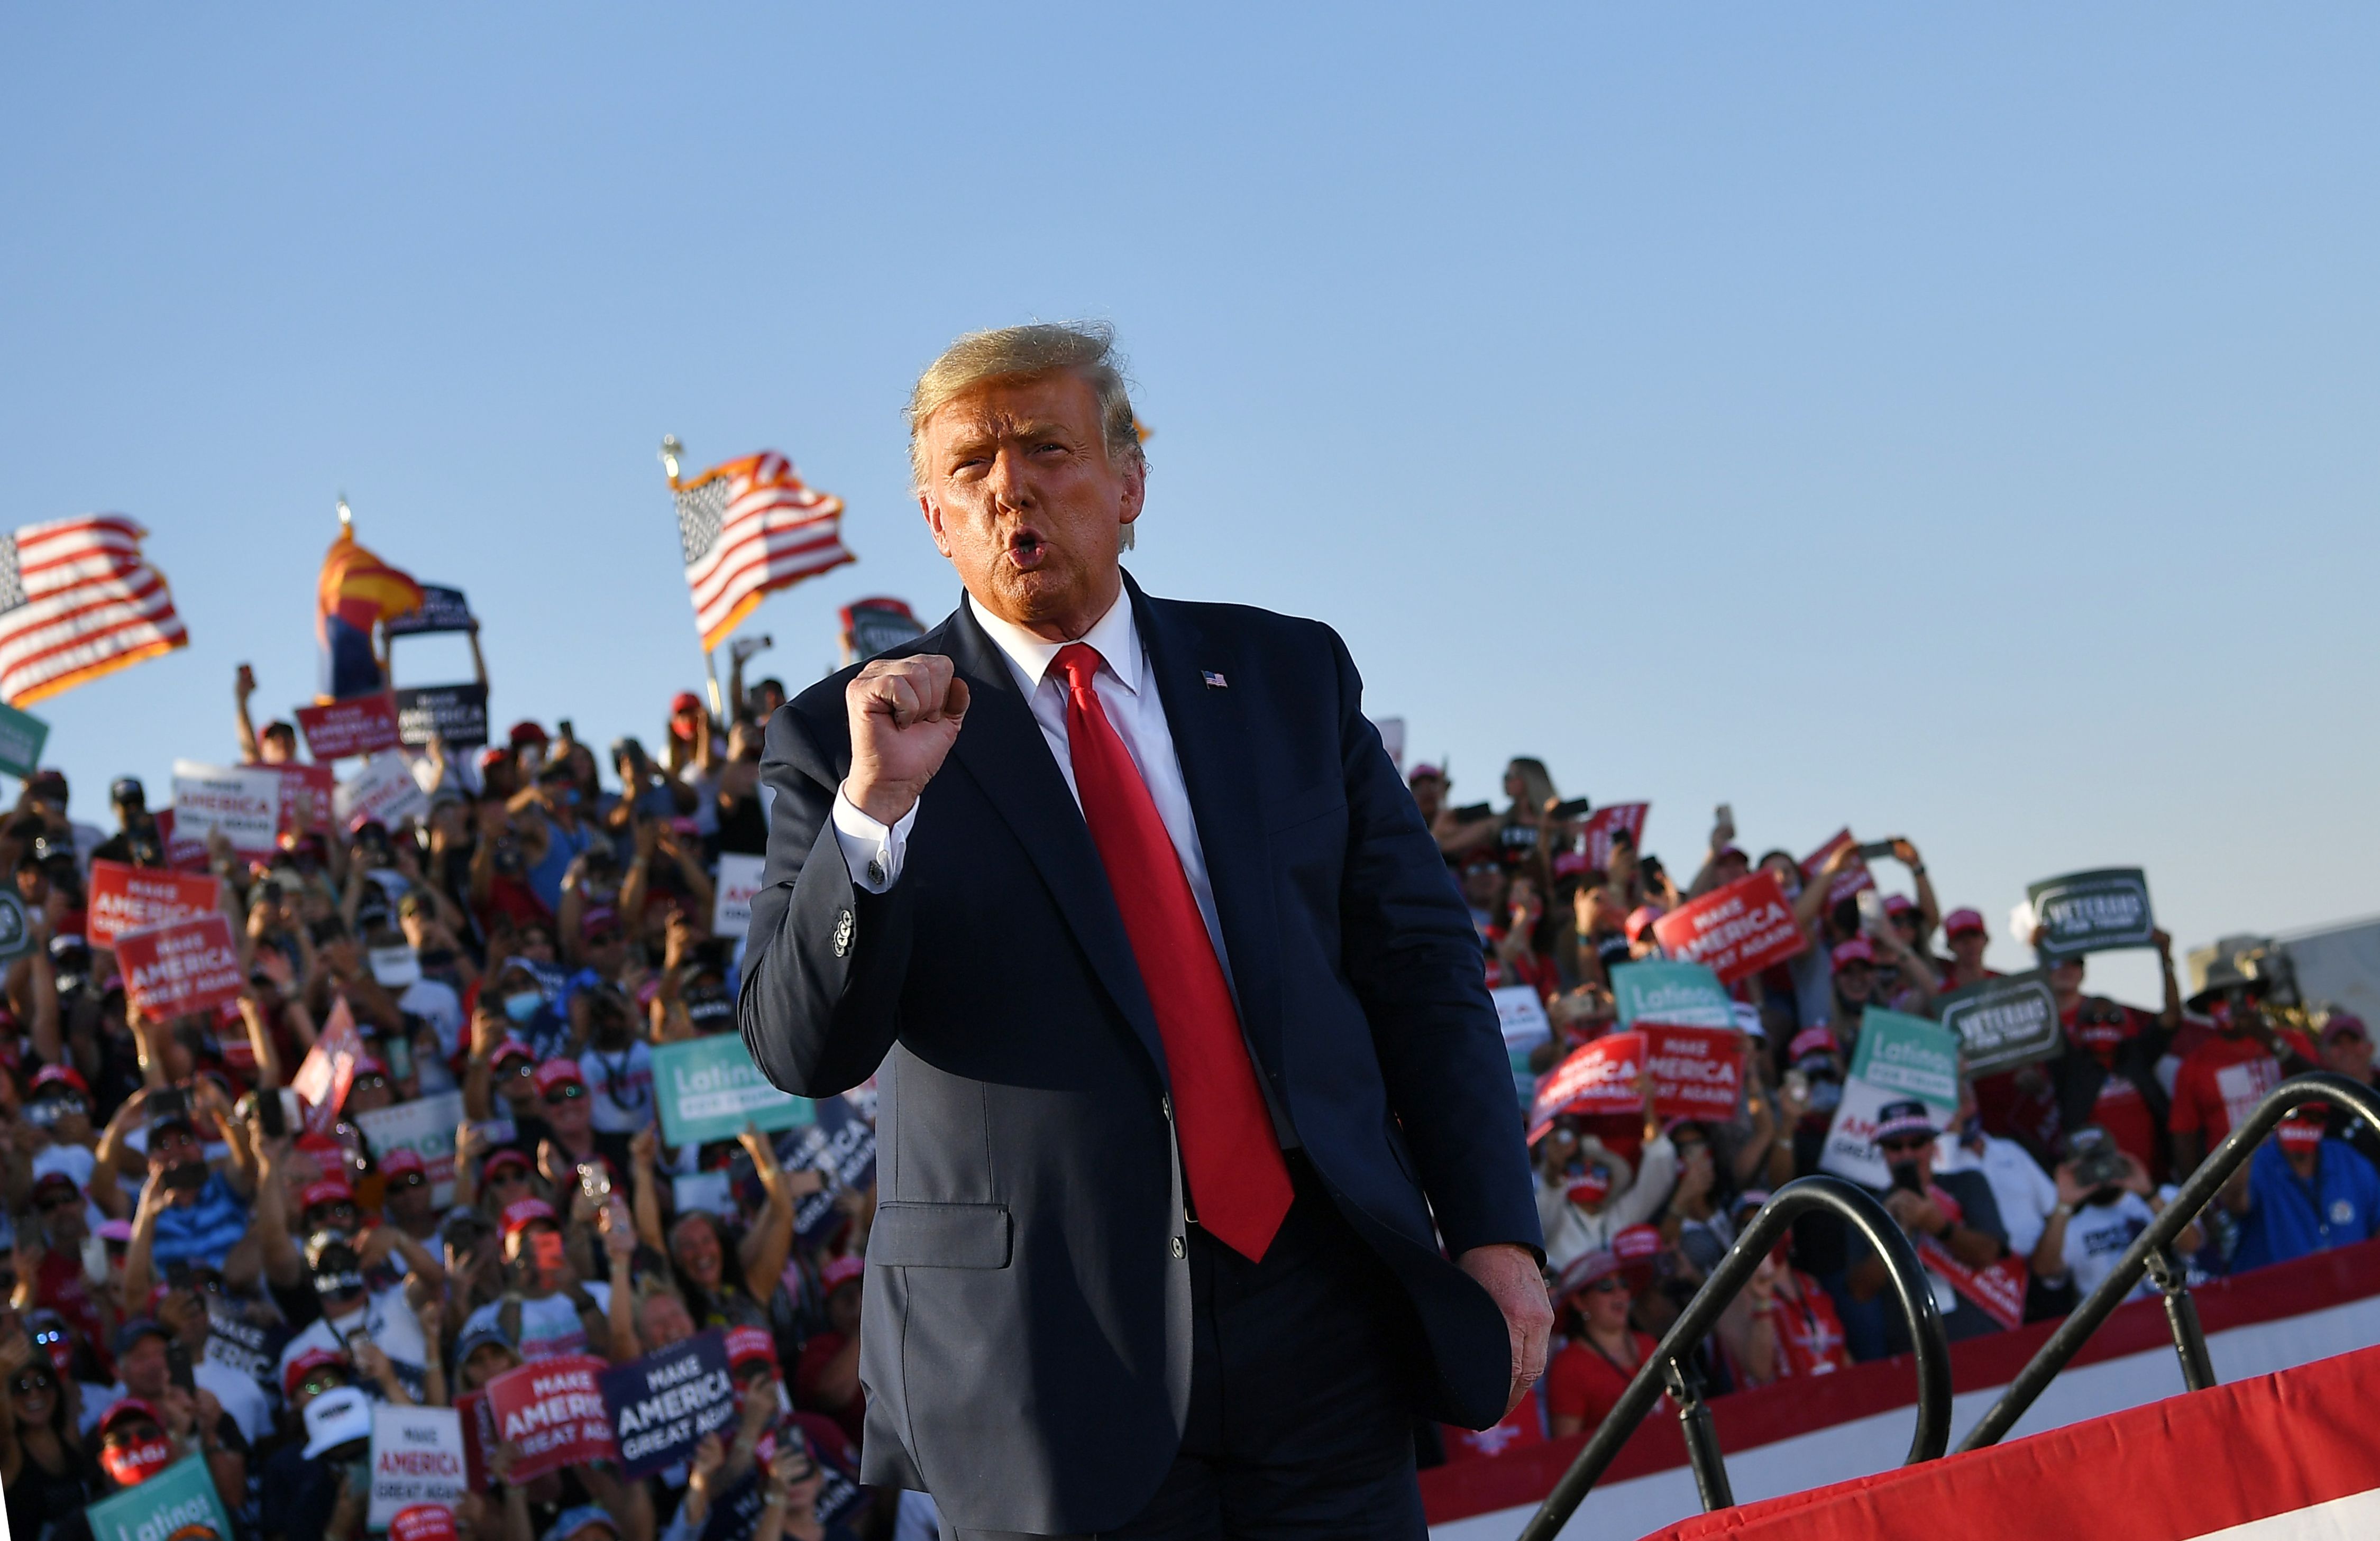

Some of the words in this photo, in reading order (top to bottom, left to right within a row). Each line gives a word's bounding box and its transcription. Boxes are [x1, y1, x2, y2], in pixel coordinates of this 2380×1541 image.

[127, 879, 179, 900] MAKE
[155, 932, 204, 956] MAKE
[132, 946, 233, 990] AMERICA
[532, 1370, 592, 1398] MAKE
[646, 1353, 701, 1393] MAKE
[520, 1423, 576, 1458] REAT
[622, 1417, 691, 1461] GREAT
[378, 1450, 459, 1477] AMERICA
